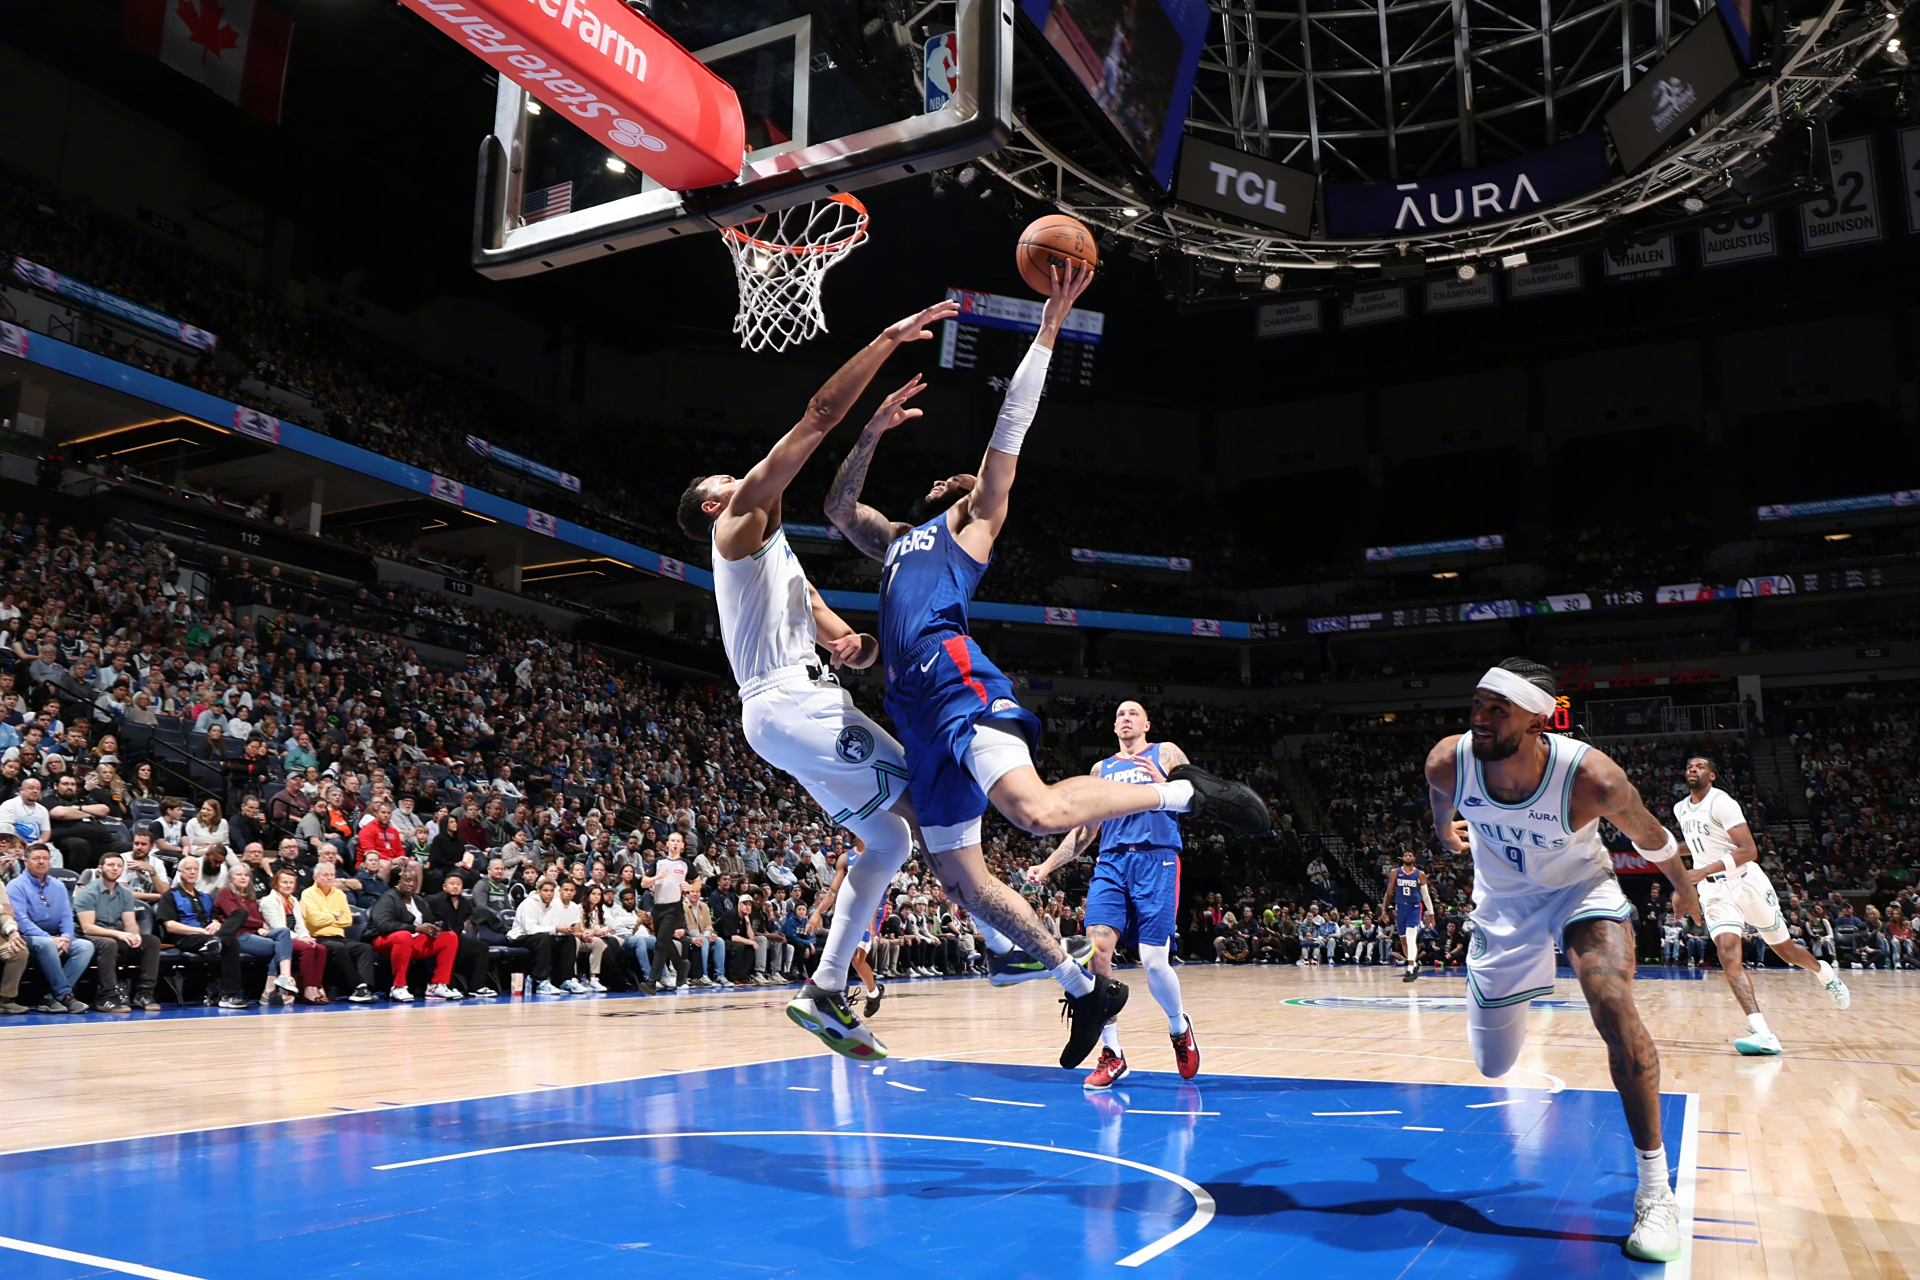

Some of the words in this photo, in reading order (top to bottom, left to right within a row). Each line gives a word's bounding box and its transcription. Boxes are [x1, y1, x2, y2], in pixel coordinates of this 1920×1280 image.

[929, 95, 946, 111] NBA
[1209, 161, 1287, 214] TCL
[1808, 215, 1874, 238] BRUNSON
[1707, 231, 1770, 254] AUGUSTUS
[1531, 262, 1559, 276] WNBA
[1517, 270, 1574, 287] CHAMPIONS
[1360, 292, 1386, 304] WNBA
[1433, 285, 1488, 300] CHAMPIONS
[1275, 304, 1301, 315] WNBA
[1348, 299, 1399, 316] CHAMPIONS
[1263, 313, 1313, 328] CHAMPIONS
[240, 531, 261, 546] 112
[452, 581, 467, 592] 113
[1603, 591, 1643, 605] 11:26
[1669, 589, 1685, 601] 21
[1564, 599, 1580, 611] 30
[1864, 648, 1881, 657] 122
[1410, 680, 1423, 689] 120
[1555, 662, 1720, 692] Budweiser
[1470, 821, 1566, 850] OLVES
[1692, 837, 1705, 853] 11
[1502, 845, 1526, 875] 9
[1403, 886, 1411, 896] 13
